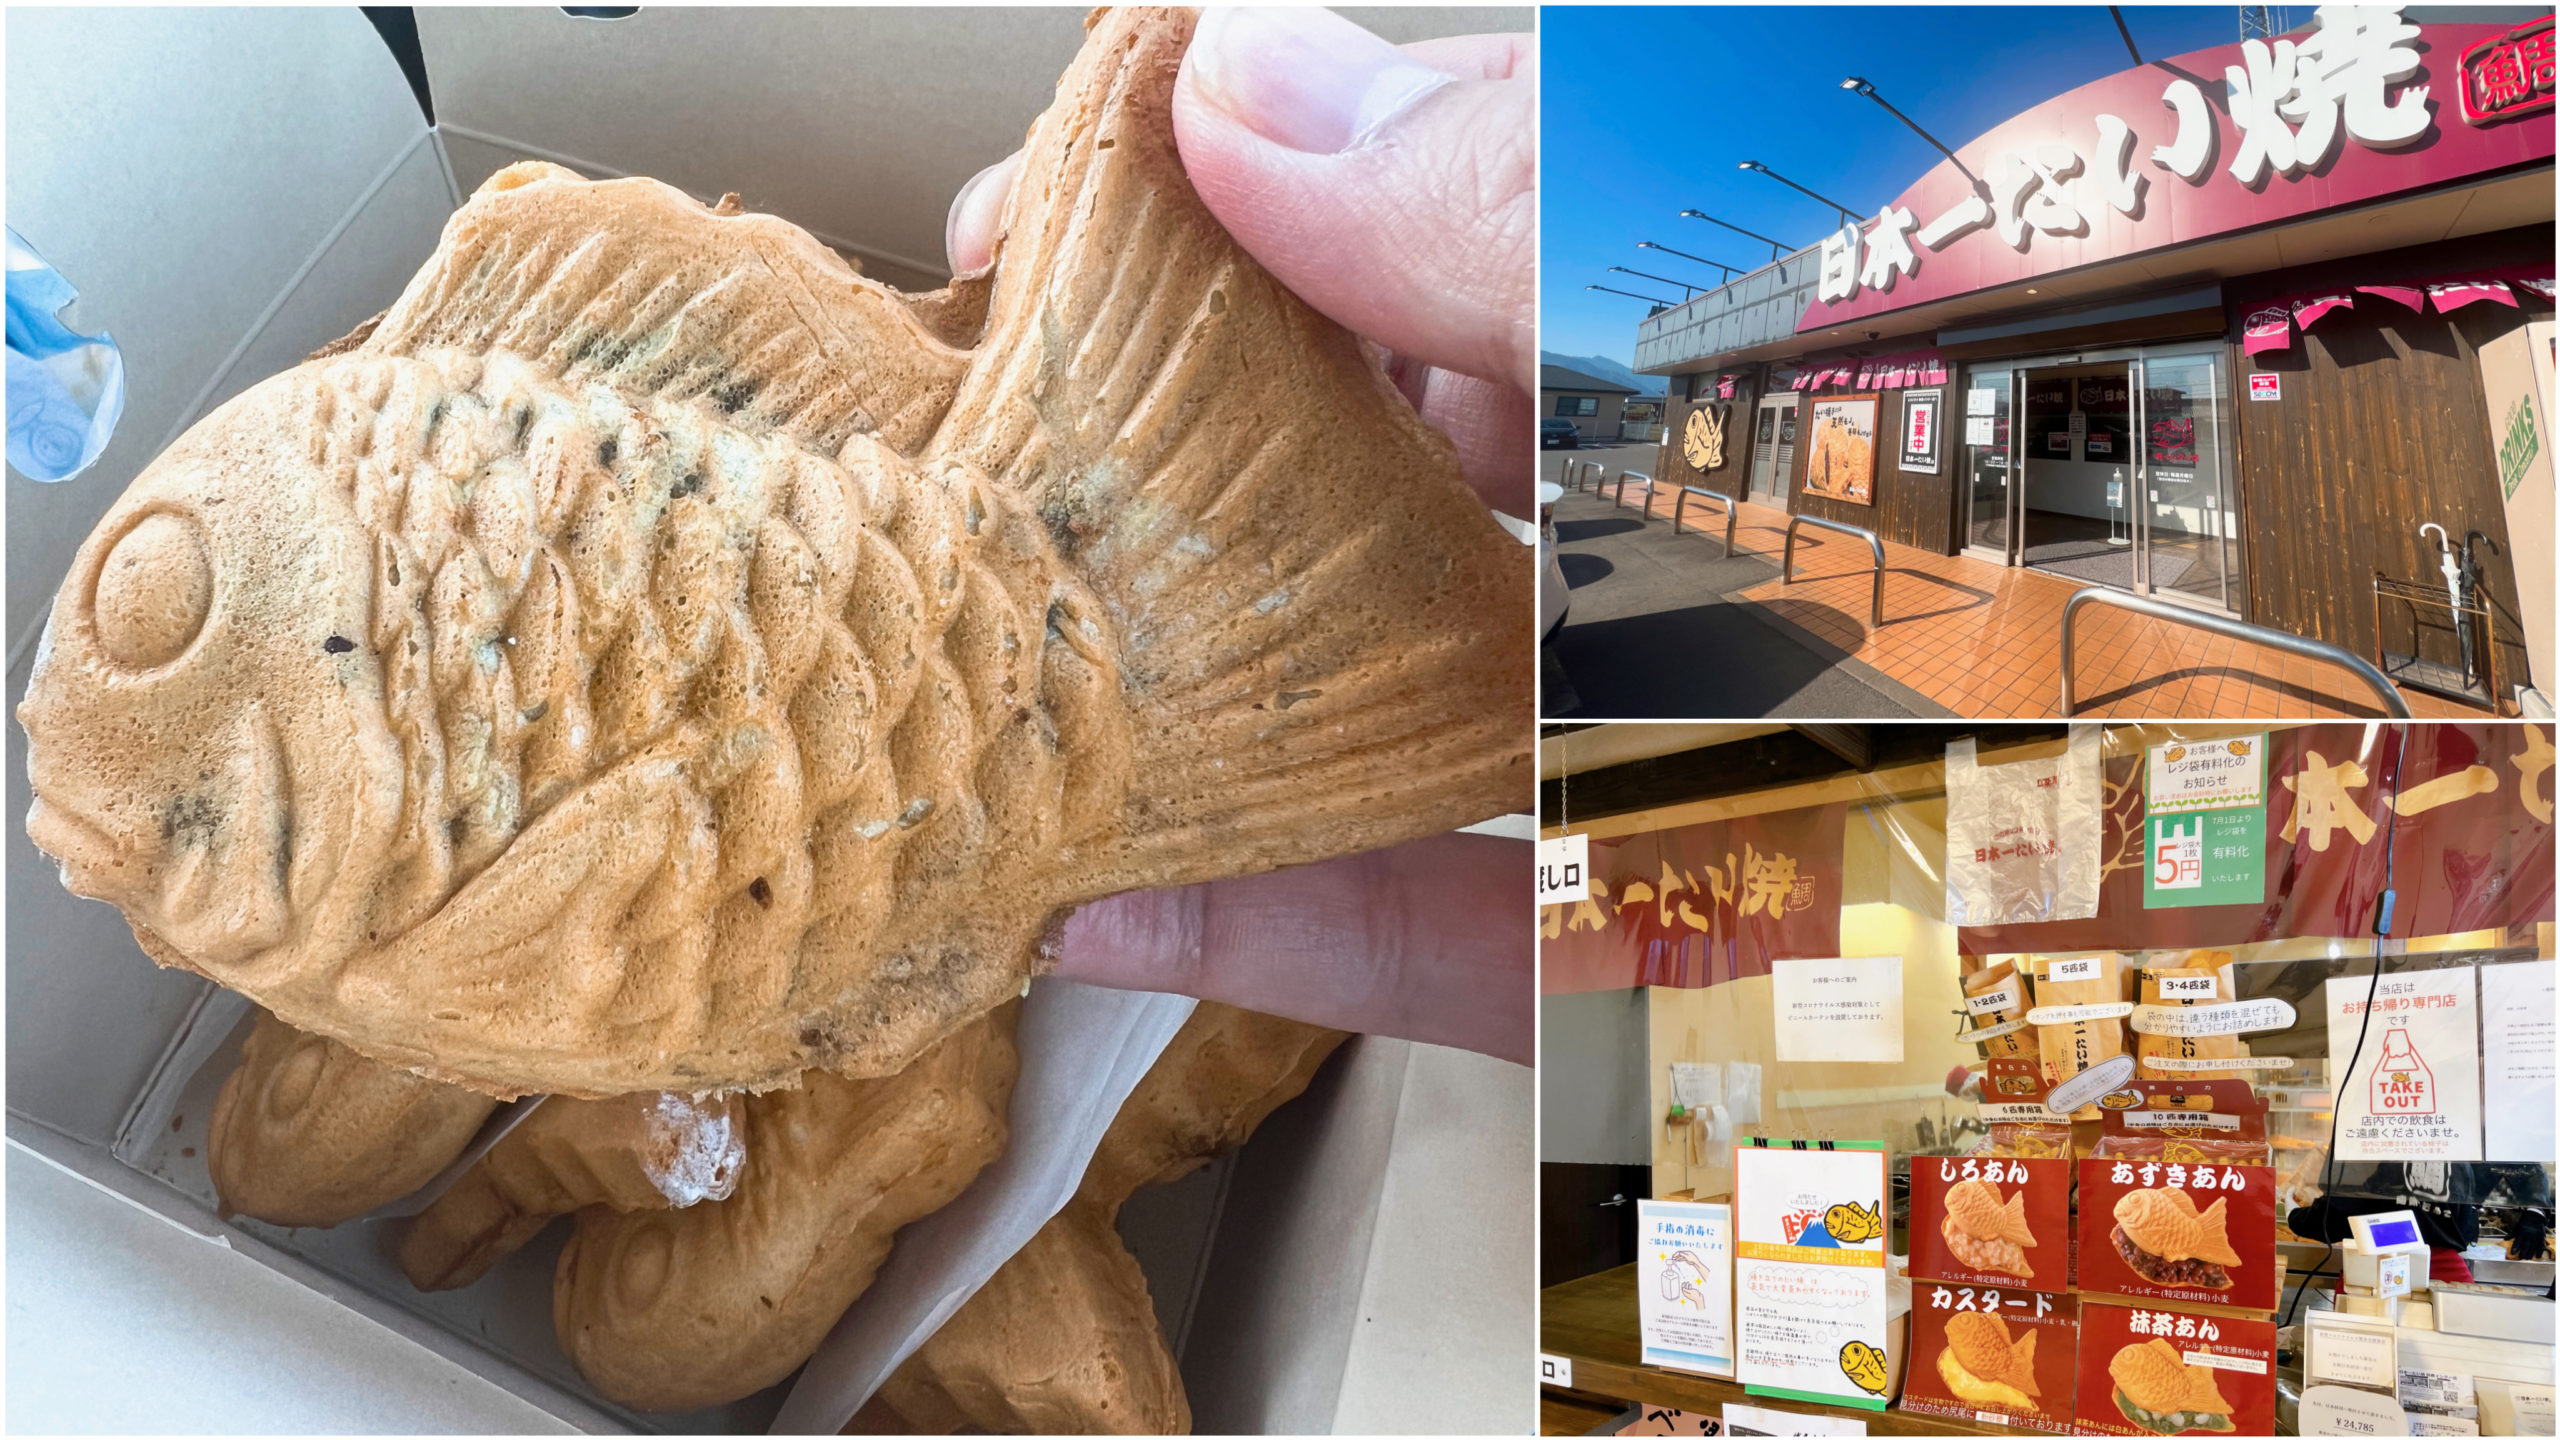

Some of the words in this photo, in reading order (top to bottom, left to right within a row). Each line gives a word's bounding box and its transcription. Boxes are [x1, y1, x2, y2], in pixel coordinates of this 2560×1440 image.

[1818, 5, 2431, 304] 日本一たい焼
[1914, 409, 1927, 452] 営業中
[2500, 394, 2535, 485] DRINKS
[2190, 744, 2225, 755] お客様へ
[2168, 756, 2246, 774] レジ袋有料化の
[2183, 775, 2228, 789] お知らせ
[2212, 815, 2251, 825] 7月1日より
[2216, 827, 2247, 836] レジ袋を
[2213, 846, 2249, 859] 有料化
[2155, 844, 2200, 884] 5円
[2212, 873, 2250, 882] いたします
[2062, 962, 2088, 974] 5匹袋
[2379, 982, 2415, 995] 当店は
[2342, 994, 2457, 1014] お持ち帰り専門店
[2387, 1015, 2410, 1025] です
[2379, 1081, 2424, 1094] TAKE
[2384, 1096, 2421, 1107] OUT
[2361, 1115, 2446, 1127] 店内での飲食は
[2345, 1127, 2460, 1139] ご遠慮くださいませ。
[1940, 1158, 2029, 1185] しろあん
[2111, 1161, 2246, 1192] あずきあん
[1656, 1222, 1716, 1236] 手指の消毒に
[1648, 1238, 1725, 1250] ご協力お願いいたします
[1941, 1272, 2029, 1288] アレルギー(特定原材料)小麦
[2120, 1284, 2230, 1304] アレルギー(特定原材料)小麦
[1932, 1285, 2053, 1318] カスタード
[2129, 1309, 2220, 1342] 抹茶あん
[2178, 1340, 2271, 1359] アレルギー(特定原材料)小麦
[2010, 1417, 2073, 1435] 付いております
